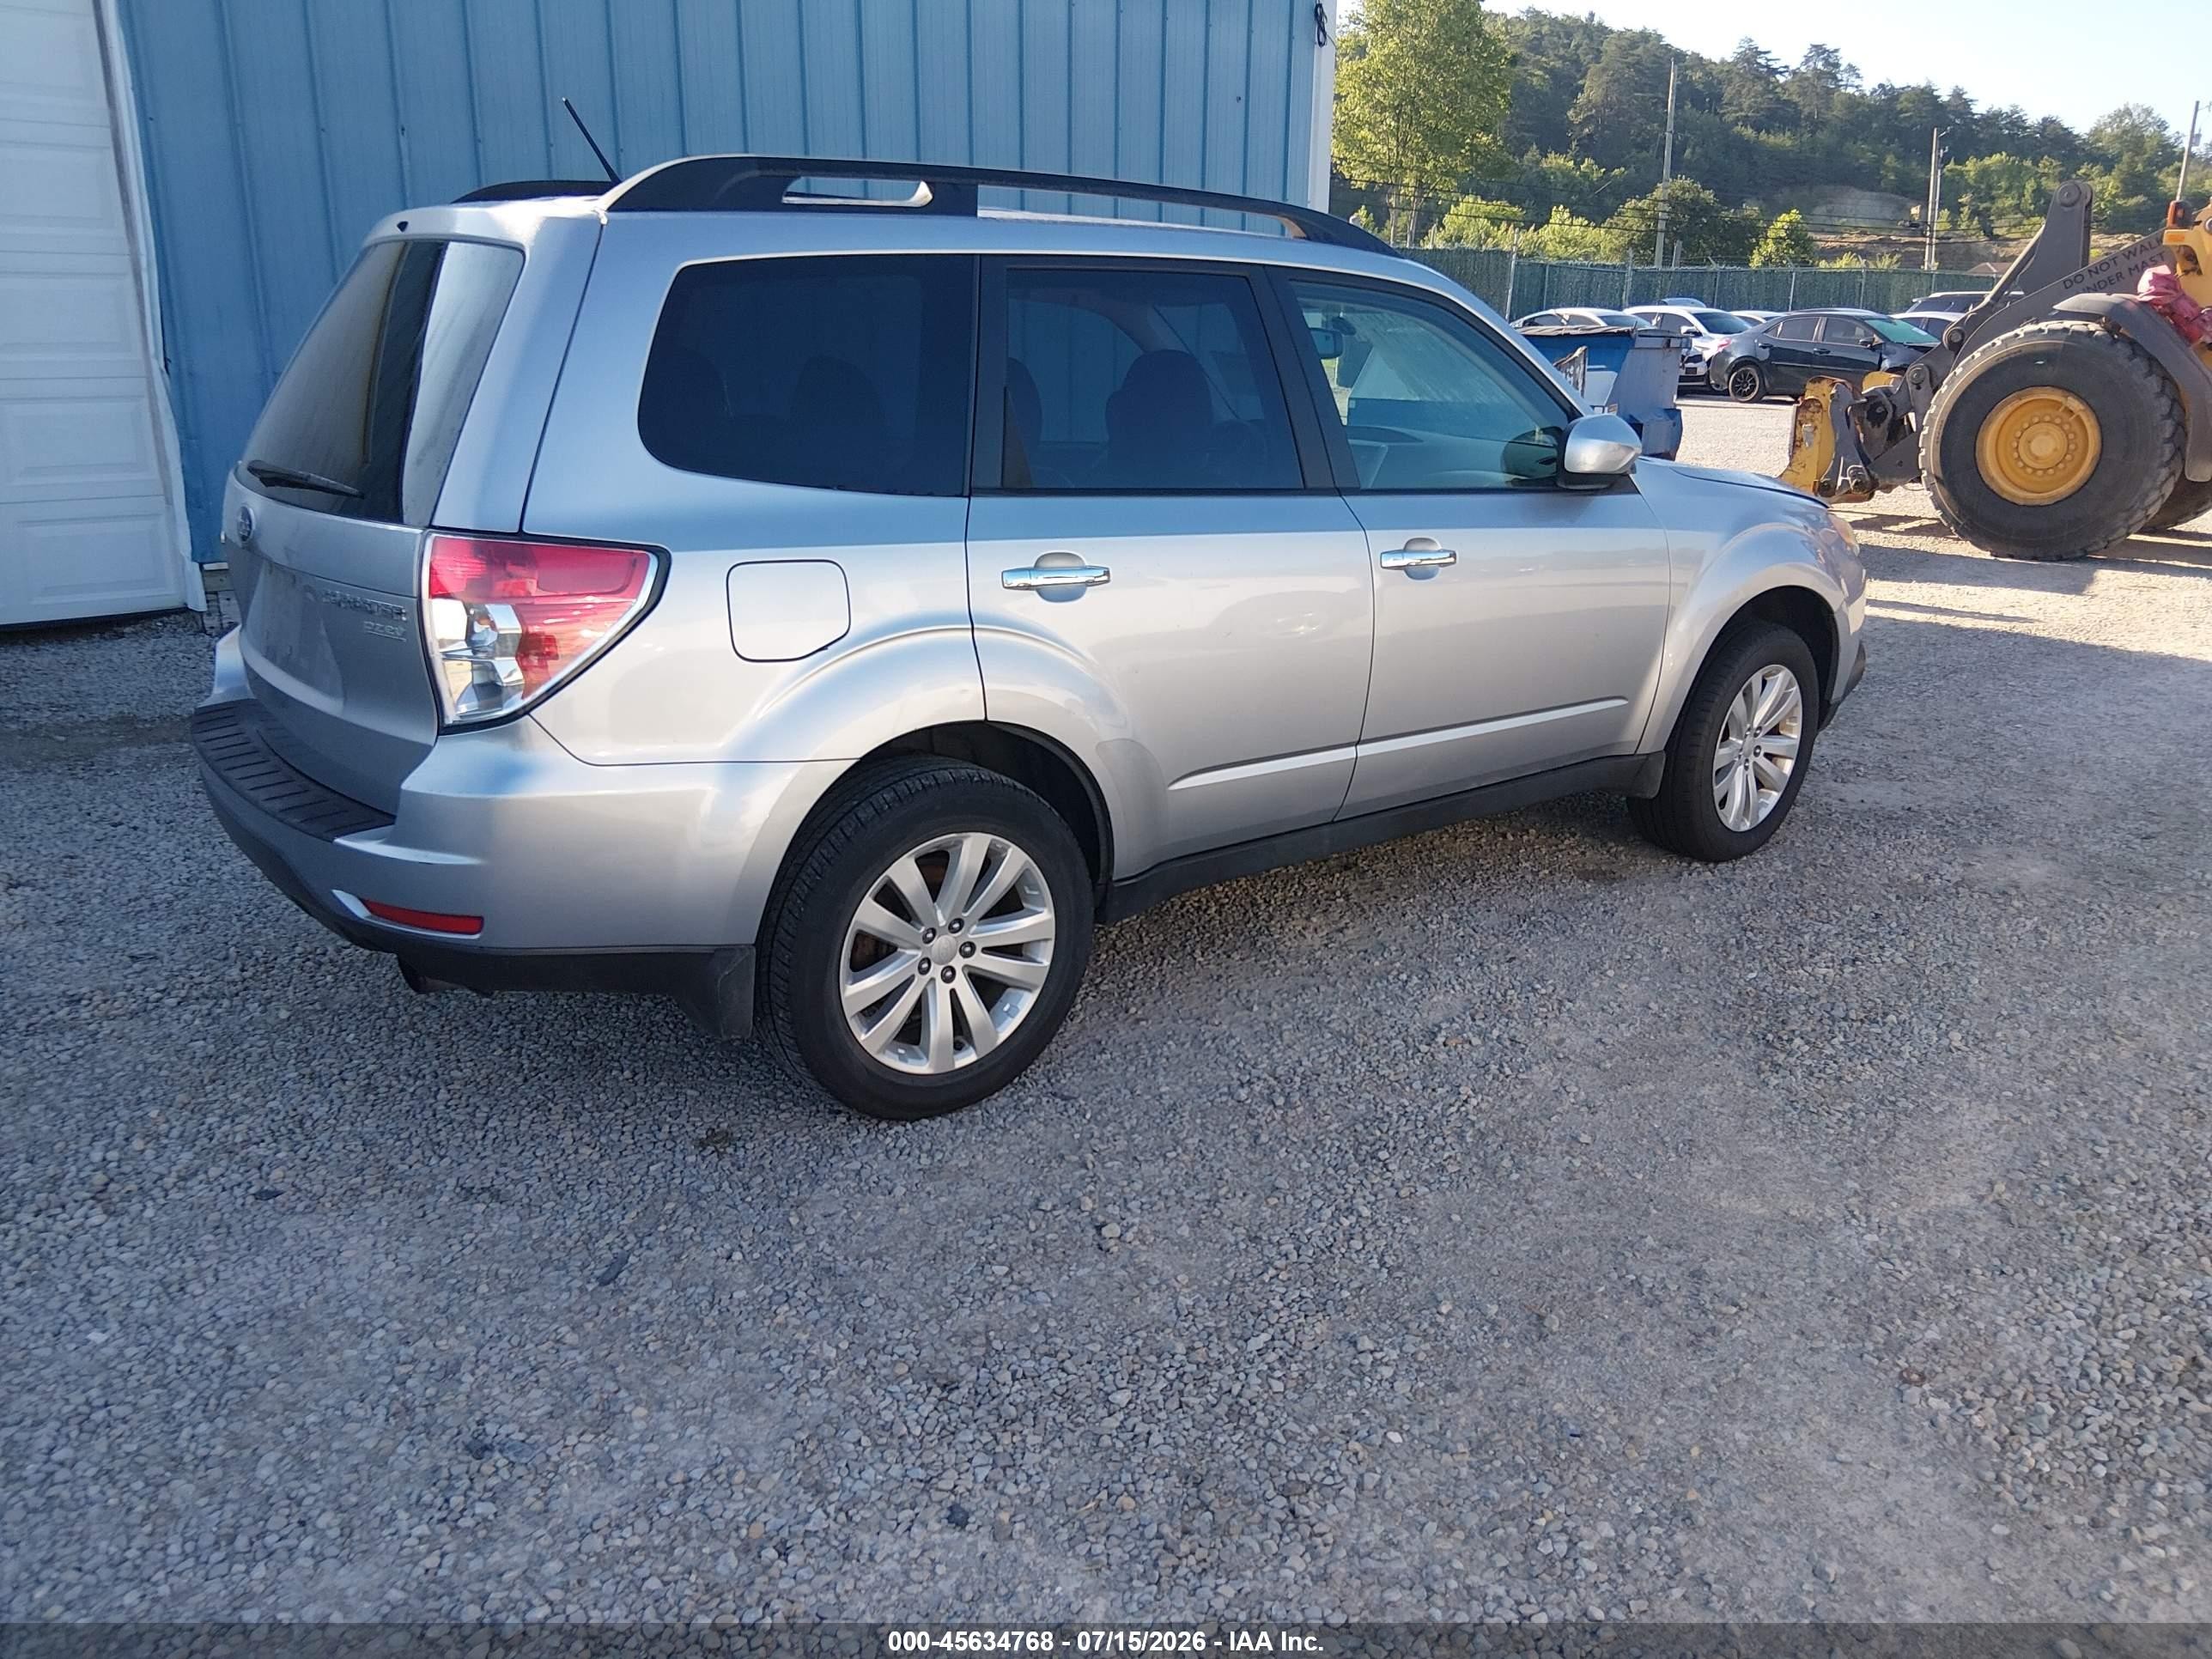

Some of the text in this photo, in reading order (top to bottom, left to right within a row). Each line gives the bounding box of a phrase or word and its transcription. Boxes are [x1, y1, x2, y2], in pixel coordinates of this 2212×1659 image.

[2063, 234, 2163, 289] DO NOT WALK
[2081, 252, 2165, 294] NDER MAST
